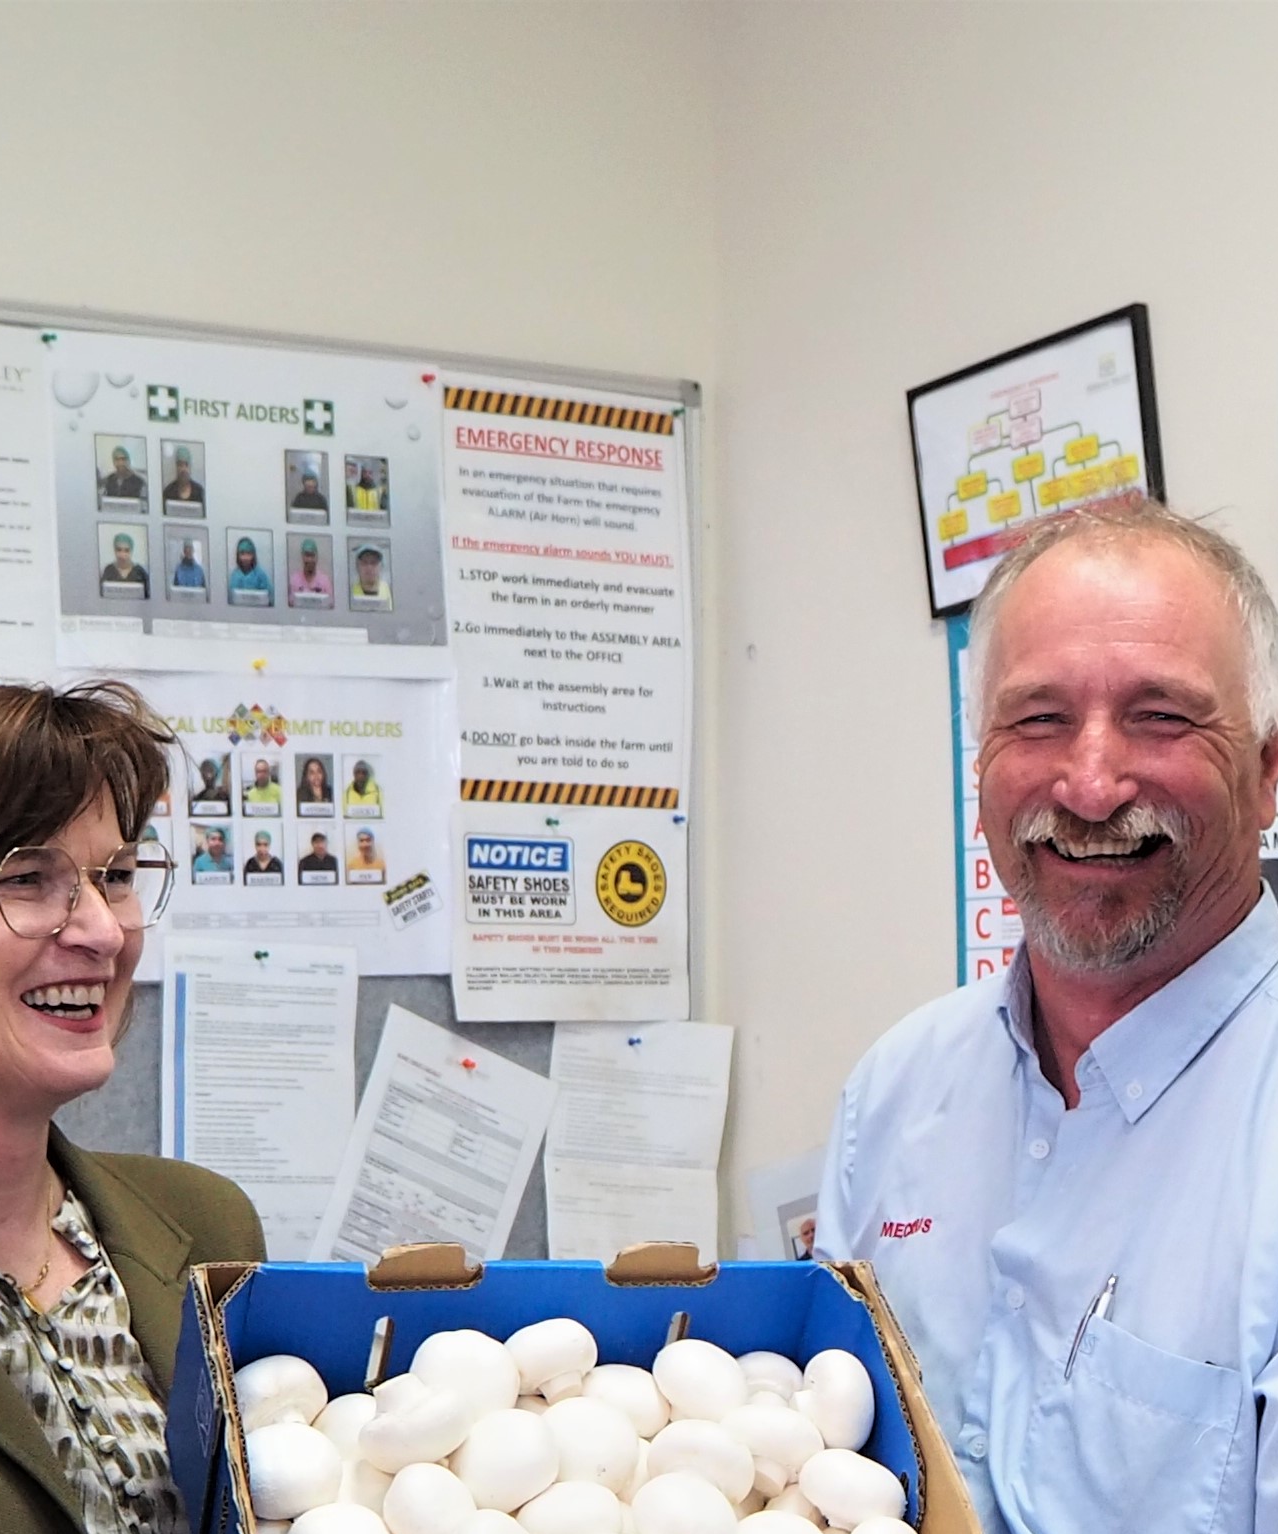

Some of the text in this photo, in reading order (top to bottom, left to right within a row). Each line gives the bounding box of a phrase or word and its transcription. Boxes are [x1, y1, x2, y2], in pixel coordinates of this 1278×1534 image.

[184, 398, 300, 424] FIRST AIDERS
[456, 427, 663, 467] EMERGENCY RESPONSE
[488, 472, 662, 498] emergency situation that requires
[462, 487, 661, 517] evacuation the the emergency
[488, 507, 601, 527] ALARM will
[462, 537, 479, 550] the
[483, 542, 540, 556] emergency
[543, 544, 573, 558] alarm
[576, 548, 611, 561] sounds
[615, 552, 637, 564] YOU
[458, 568, 675, 597] 1.STOP work immediately and evacuate
[491, 591, 655, 615] the farm in an orderly manner
[453, 621, 681, 648] 2.Go immediately to the ASSEMBLY AREA
[524, 647, 623, 664] next to the OFFICE
[483, 676, 654, 698] 3.Wait at the assembly area for
[542, 700, 607, 714] instructions
[329, 717, 403, 738] HOLDERS
[493, 733, 516, 746] NOT
[520, 735, 534, 746] go
[537, 735, 562, 746] back
[565, 736, 597, 748] inside
[600, 738, 617, 750] the
[620, 740, 646, 751] farm
[649, 742, 674, 753] until
[517, 756, 629, 770] you are told to do so
[471, 844, 563, 867] NOTICE
[468, 875, 570, 893] SAFETY SHOES
[975, 858, 991, 890] B
[472, 894, 567, 906] MUST BE WORN
[603, 896, 661, 924] REQUIRED
[477, 908, 562, 919] IN THIS AREA
[975, 908, 991, 939] C
